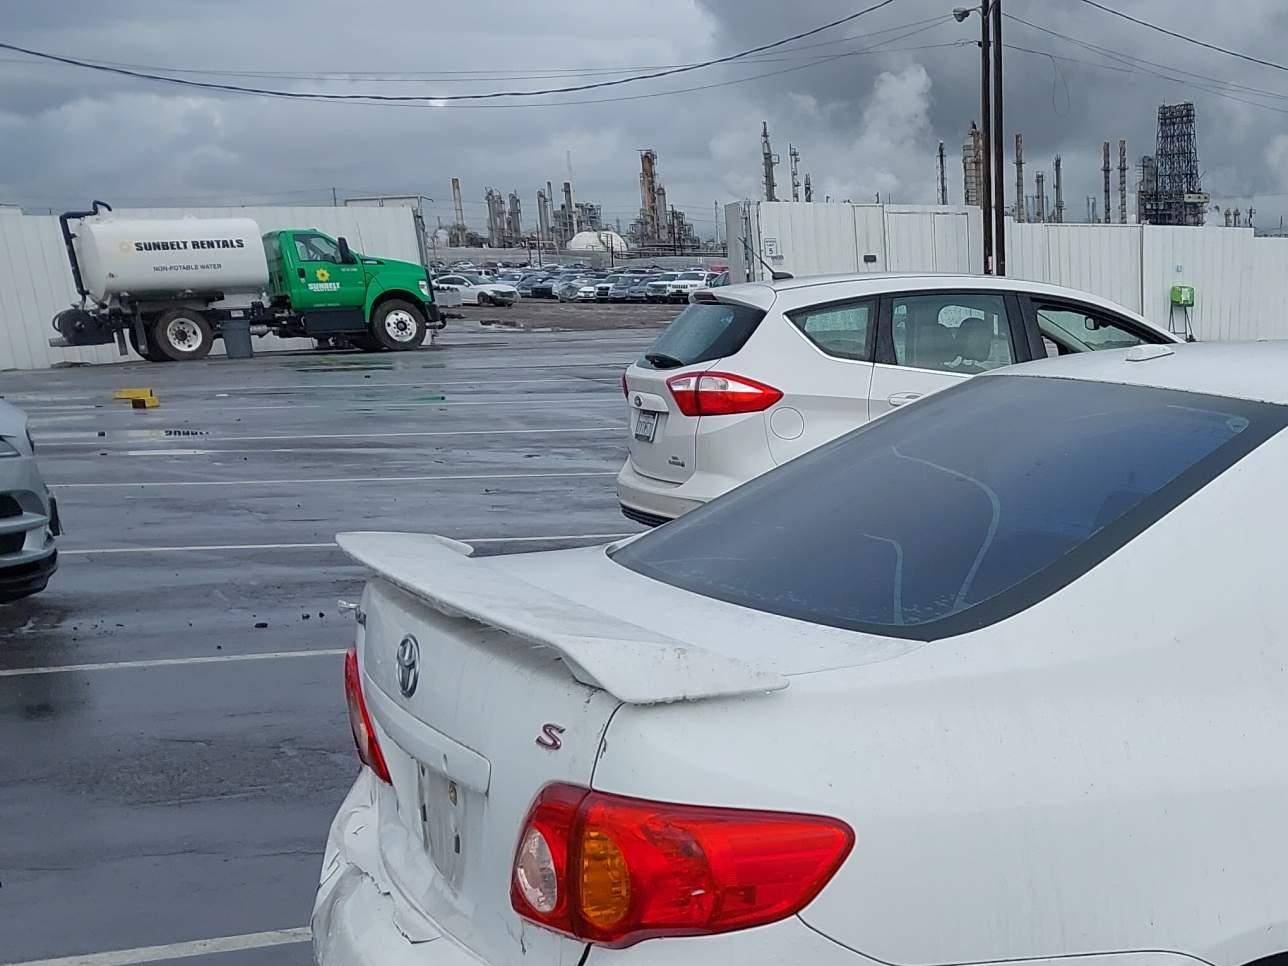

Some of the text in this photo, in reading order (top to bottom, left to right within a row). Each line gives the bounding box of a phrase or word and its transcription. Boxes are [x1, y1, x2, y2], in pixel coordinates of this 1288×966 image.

[134, 239, 245, 251] SUNBELT RENTALS
[153, 263, 222, 273] NON-POTABLE WATER
[535, 723, 566, 750] S
